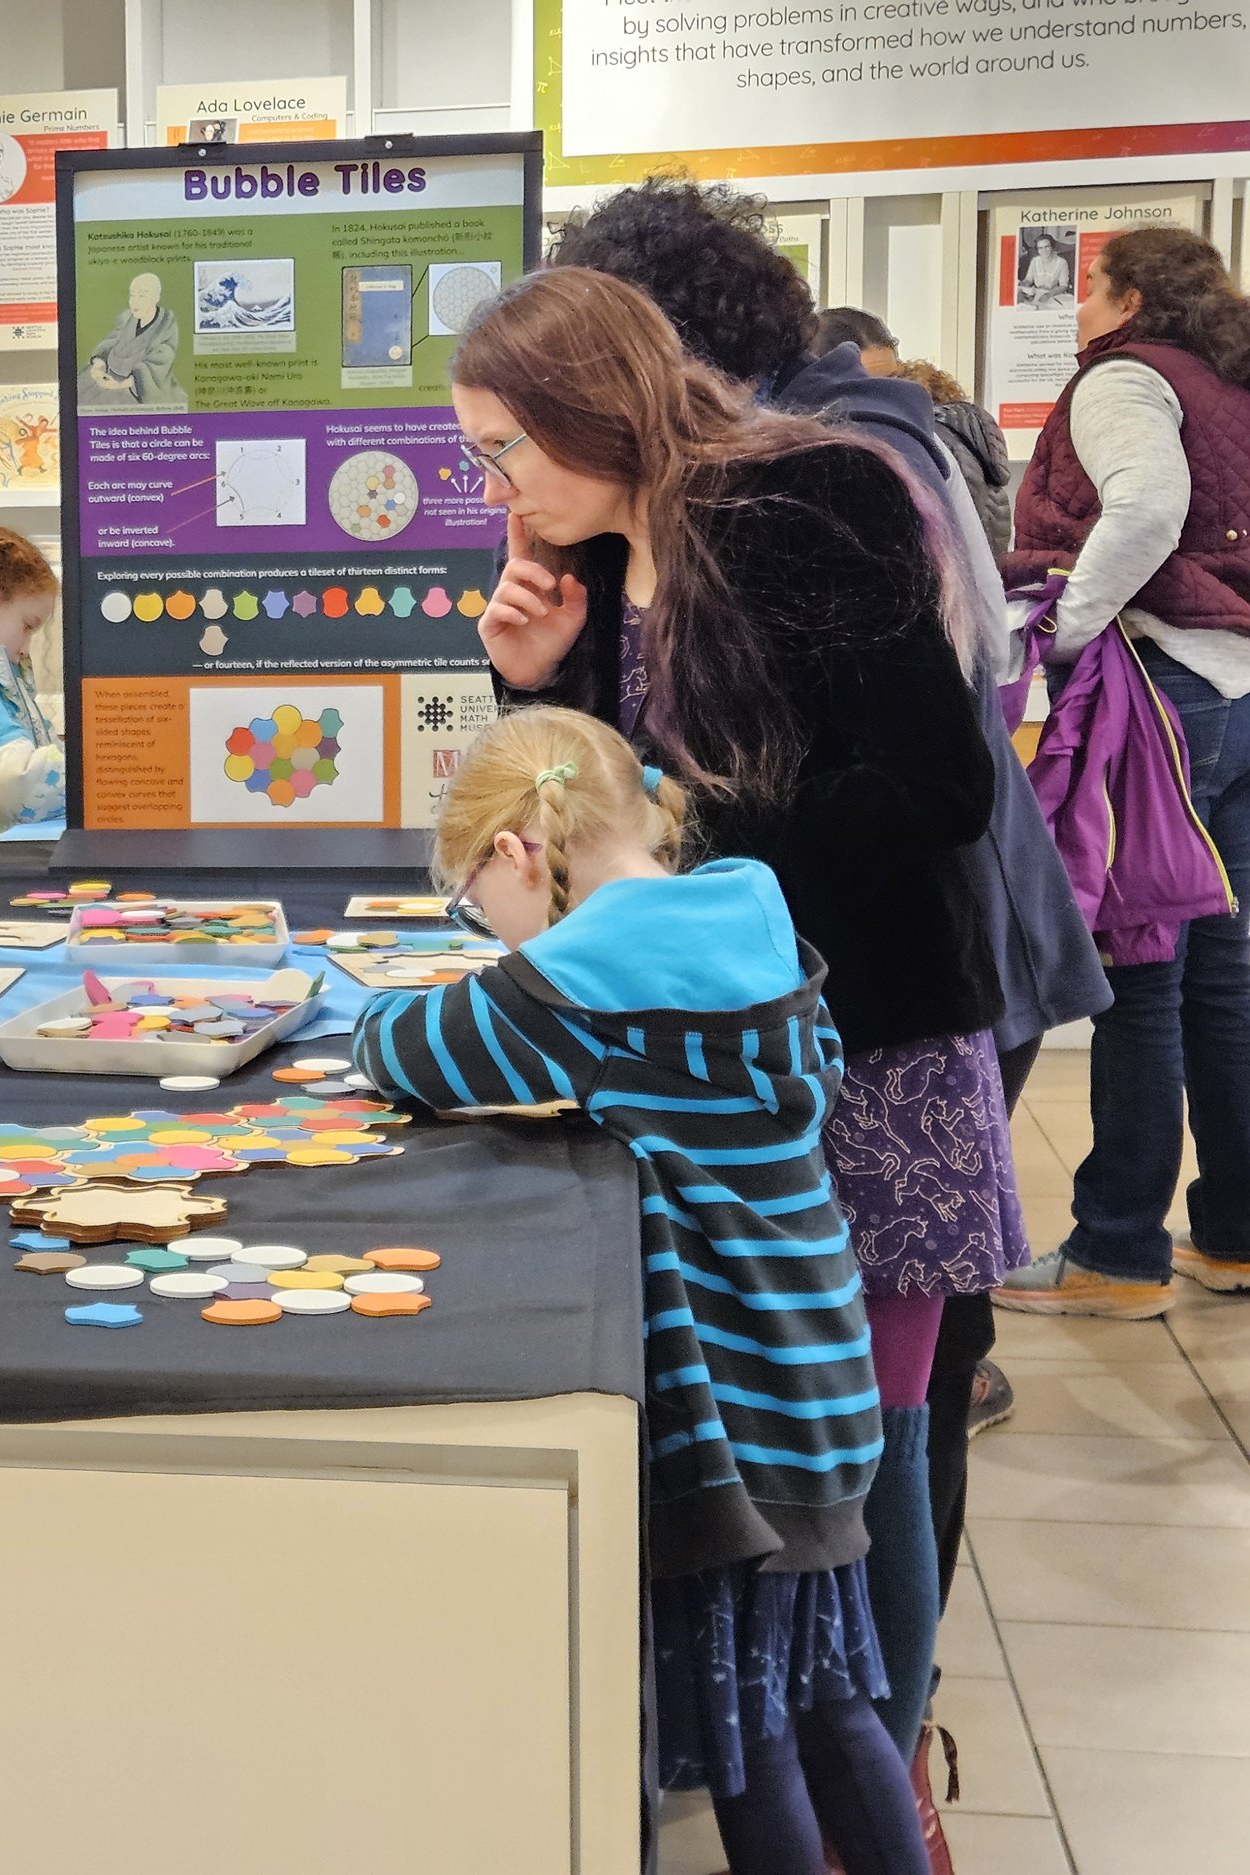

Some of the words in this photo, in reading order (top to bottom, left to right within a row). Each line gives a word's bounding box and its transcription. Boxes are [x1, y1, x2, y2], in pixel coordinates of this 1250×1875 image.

[623, 16, 649, 38] by
[655, 12, 727, 34] solving
[734, 6, 833, 33] problems
[840, 3, 856, 22] in
[863, 0, 949, 20] creative
[956, 0, 1016, 17] ways,
[591, 46, 669, 69] insights
[675, 43, 716, 62] that
[723, 40, 773, 60] have
[780, 30, 913, 56] transformed
[921, 28, 966, 47] how
[972, 26, 1004, 43] we
[1010, 15, 1136, 41] understand
[1142, 11, 1247, 33] numbers,
[736, 69, 816, 91] shapes,
[822, 62, 863, 84] and
[869, 61, 904, 80] the
[909, 55, 969, 78] world
[976, 50, 1054, 74] around
[1061, 52, 1090, 69] us.
[197, 99, 228, 113] Ada
[234, 97, 306, 112] Lovelace
[20, 107, 88, 123] Germain
[251, 113, 292, 123] Computers
[302, 112, 328, 121] Coding
[44, 125, 65, 133] Prime
[66, 123, 100, 132] Numbers
[184, 164, 320, 201] Bubble
[334, 161, 426, 195] Tiles
[1020, 208, 1099, 223] Katherine
[1104, 205, 1172, 221] Johnson
[90, 427, 107, 436] The
[108, 427, 127, 436] idea
[129, 426, 159, 435] behind
[161, 425, 192, 435] Bubble
[326, 425, 362, 434] Hokusai
[364, 425, 392, 433] seems
[394, 424, 403, 432] to
[405, 423, 427, 432] have
[90, 441, 111, 450] Tiles
[112, 440, 120, 449] is
[121, 440, 140, 449] that
[150, 439, 173, 448] circle
[192, 438, 203, 447] be
[327, 437, 346, 446] with
[348, 436, 384, 446] different
[386, 435, 445, 445] combinations
[447, 435, 458, 444] of
[90, 454, 115, 462] made
[117, 453, 127, 461] of
[128, 453, 140, 461] six
[142, 452, 188, 463] 60-degree
[88, 481, 110, 490] Each
[128, 482, 147, 491] may
[148, 481, 173, 489] curve
[88, 494, 126, 503] outward
[128, 493, 164, 503] (convex)
[423, 497, 443, 505] three
[458, 507, 465, 515] in
[467, 507, 478, 515] his
[479, 507, 507, 517] origina
[109, 526, 120, 535] be
[122, 526, 159, 535] inverted
[98, 539, 129, 548] inward
[131, 538, 175, 549] (concave).
[97, 571, 138, 582] Exploring
[140, 572, 164, 581] every
[166, 570, 201, 580] possible
[203, 569, 256, 578] combination
[258, 569, 298, 579] produces
[308, 568, 335, 576] tileset
[337, 568, 346, 576] of
[347, 567, 383, 576] thirteen
[385, 566, 417, 575] distinct
[418, 565, 447, 574] forms:
[215, 661, 255, 670] fourteen,
[256, 660, 263, 668] if
[264, 660, 279, 668] the
[280, 659, 318, 668] reflected
[353, 659, 363, 667] of
[364, 659, 379, 667] the
[381, 659, 432, 669] asymmetric
[434, 658, 447, 666] tile
[449, 658, 479, 666] counts
